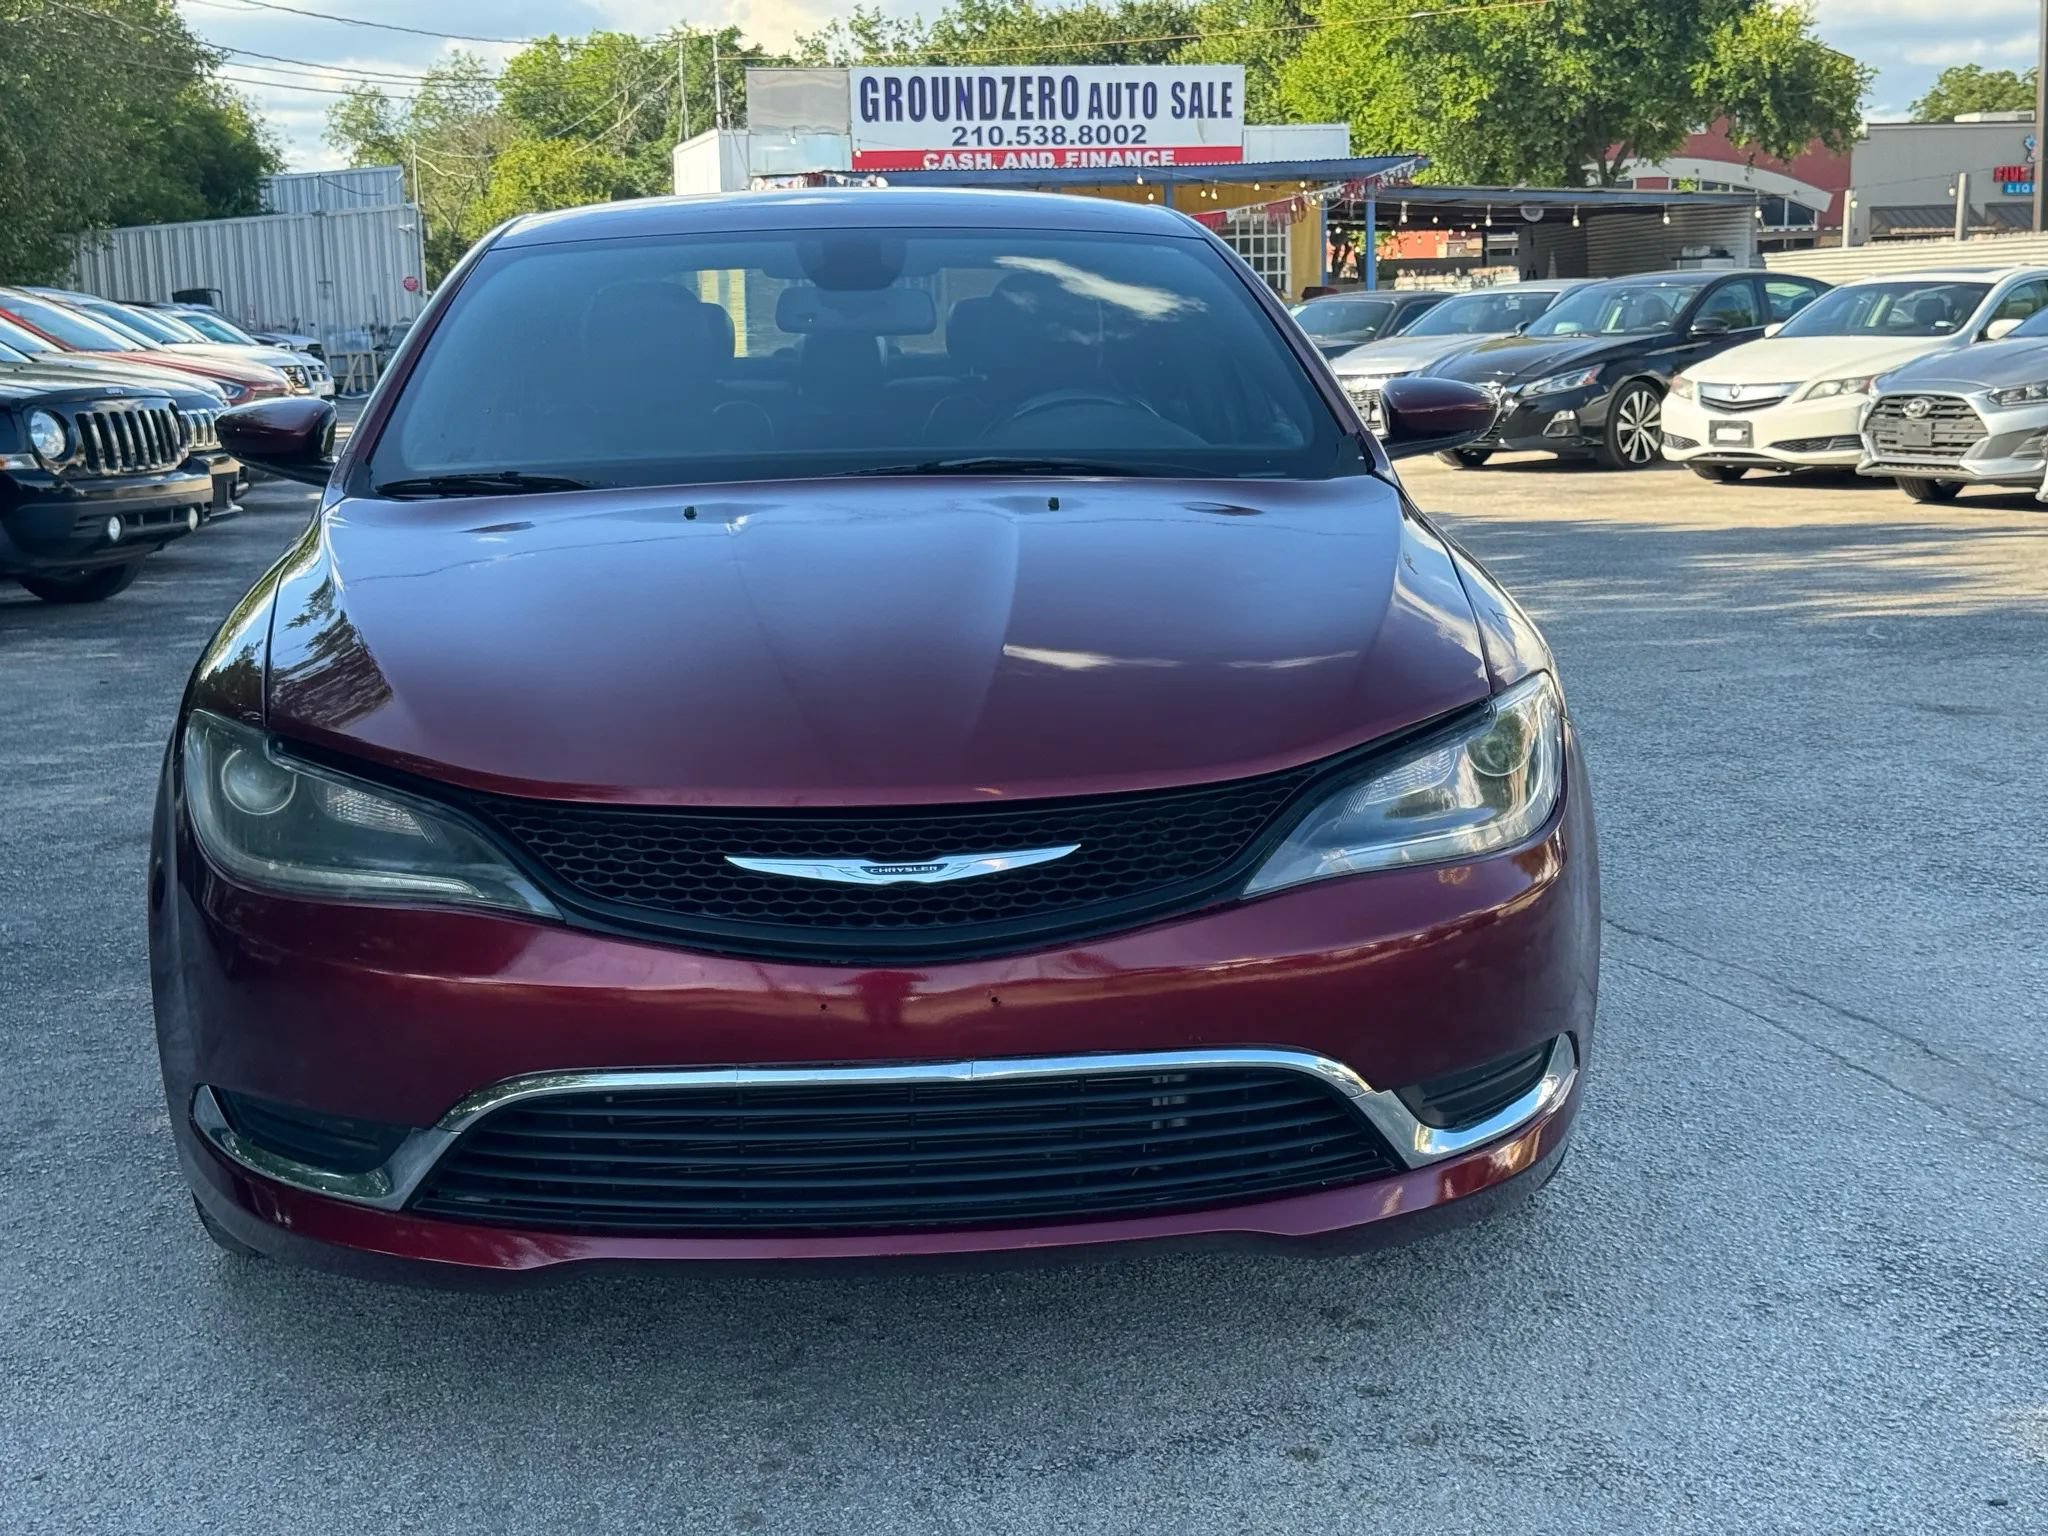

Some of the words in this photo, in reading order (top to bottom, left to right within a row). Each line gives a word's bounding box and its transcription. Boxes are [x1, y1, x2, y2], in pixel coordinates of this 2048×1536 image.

[860, 75, 1079, 122] GROUNDZERO
[1088, 82, 1157, 119] AUTO
[1171, 81, 1232, 119] SALE
[952, 124, 1147, 147] 210.538.8002
[923, 153, 993, 169] CASH
[1003, 152, 1056, 168] AND
[1065, 150, 1175, 167] FINANCE
